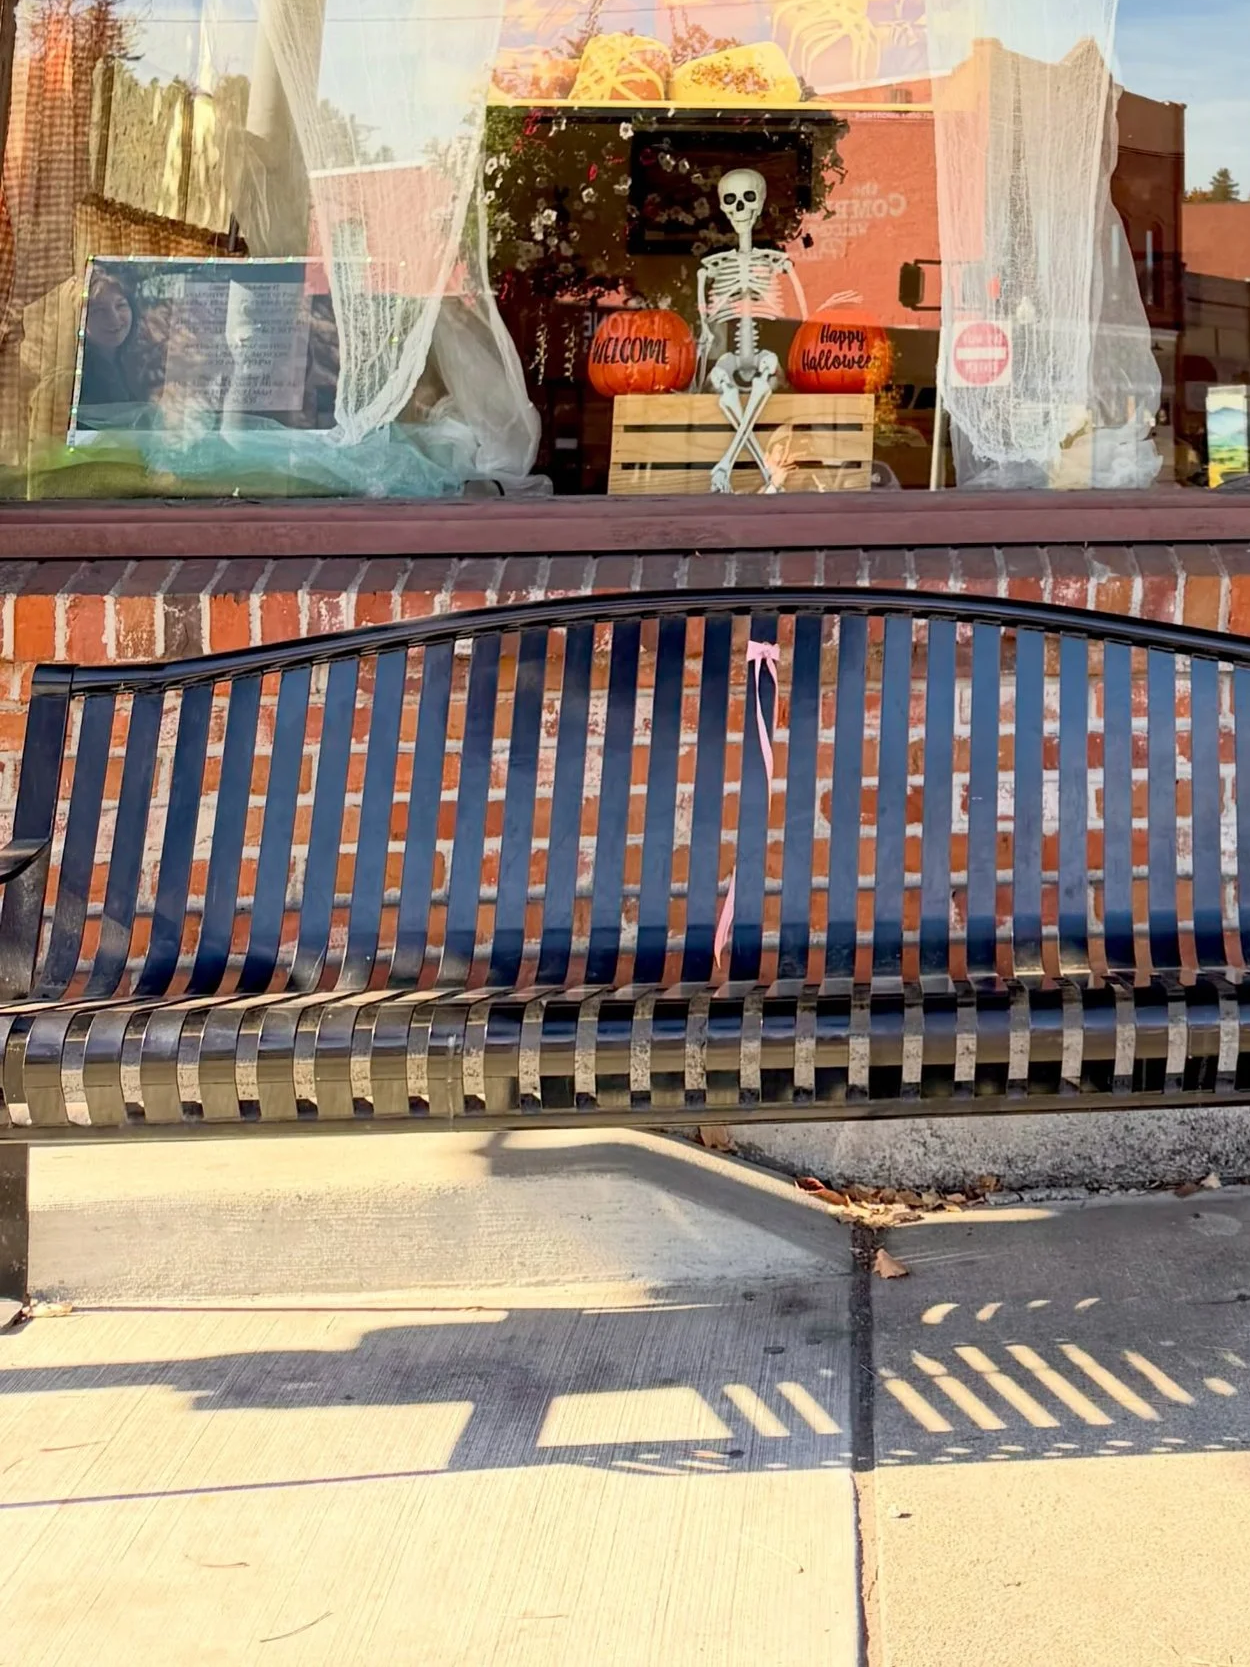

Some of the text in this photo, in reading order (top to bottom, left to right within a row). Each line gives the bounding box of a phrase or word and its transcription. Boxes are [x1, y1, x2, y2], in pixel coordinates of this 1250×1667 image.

[592, 336, 671, 364] WELCOME
[820, 323, 867, 351] Happy
[802, 349, 873, 372] Hallowee
